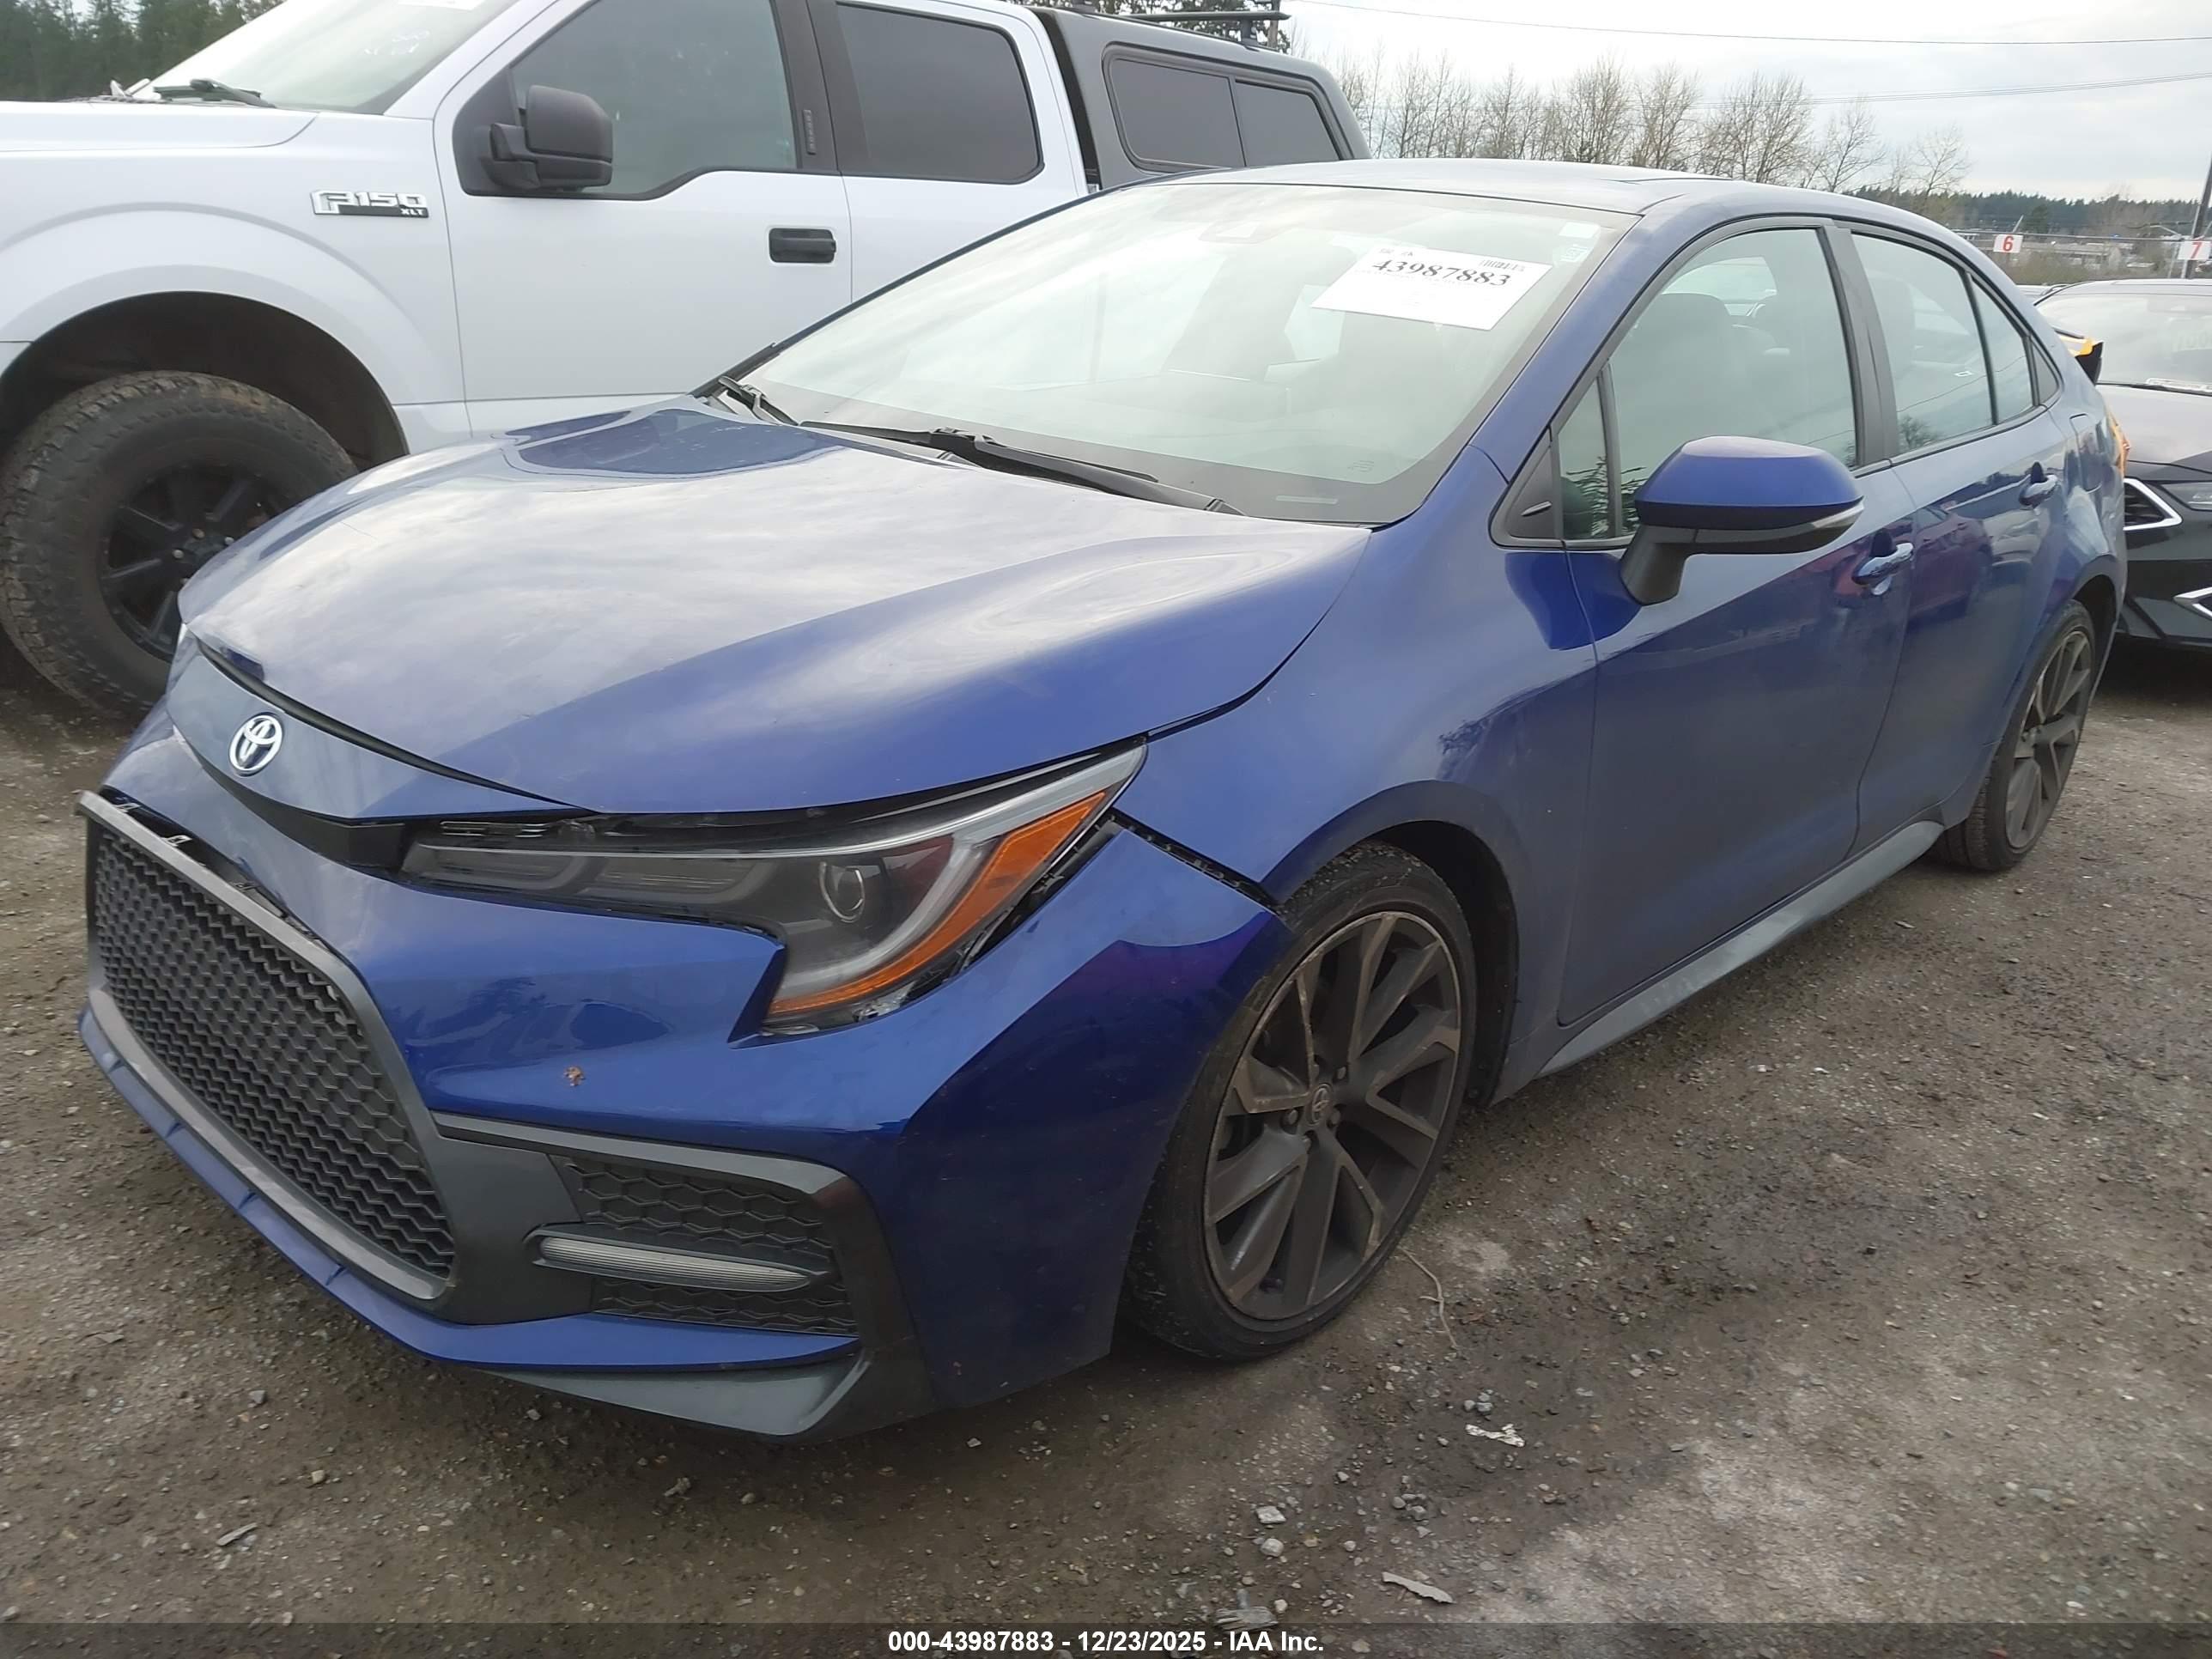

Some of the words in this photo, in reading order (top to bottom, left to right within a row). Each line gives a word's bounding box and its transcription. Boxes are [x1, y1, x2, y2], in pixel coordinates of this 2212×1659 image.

[400, 208, 425, 216] XLT
[2003, 235, 2014, 252] 6
[2191, 241, 2203, 259] 7
[1372, 258, 1512, 287] 43987883
